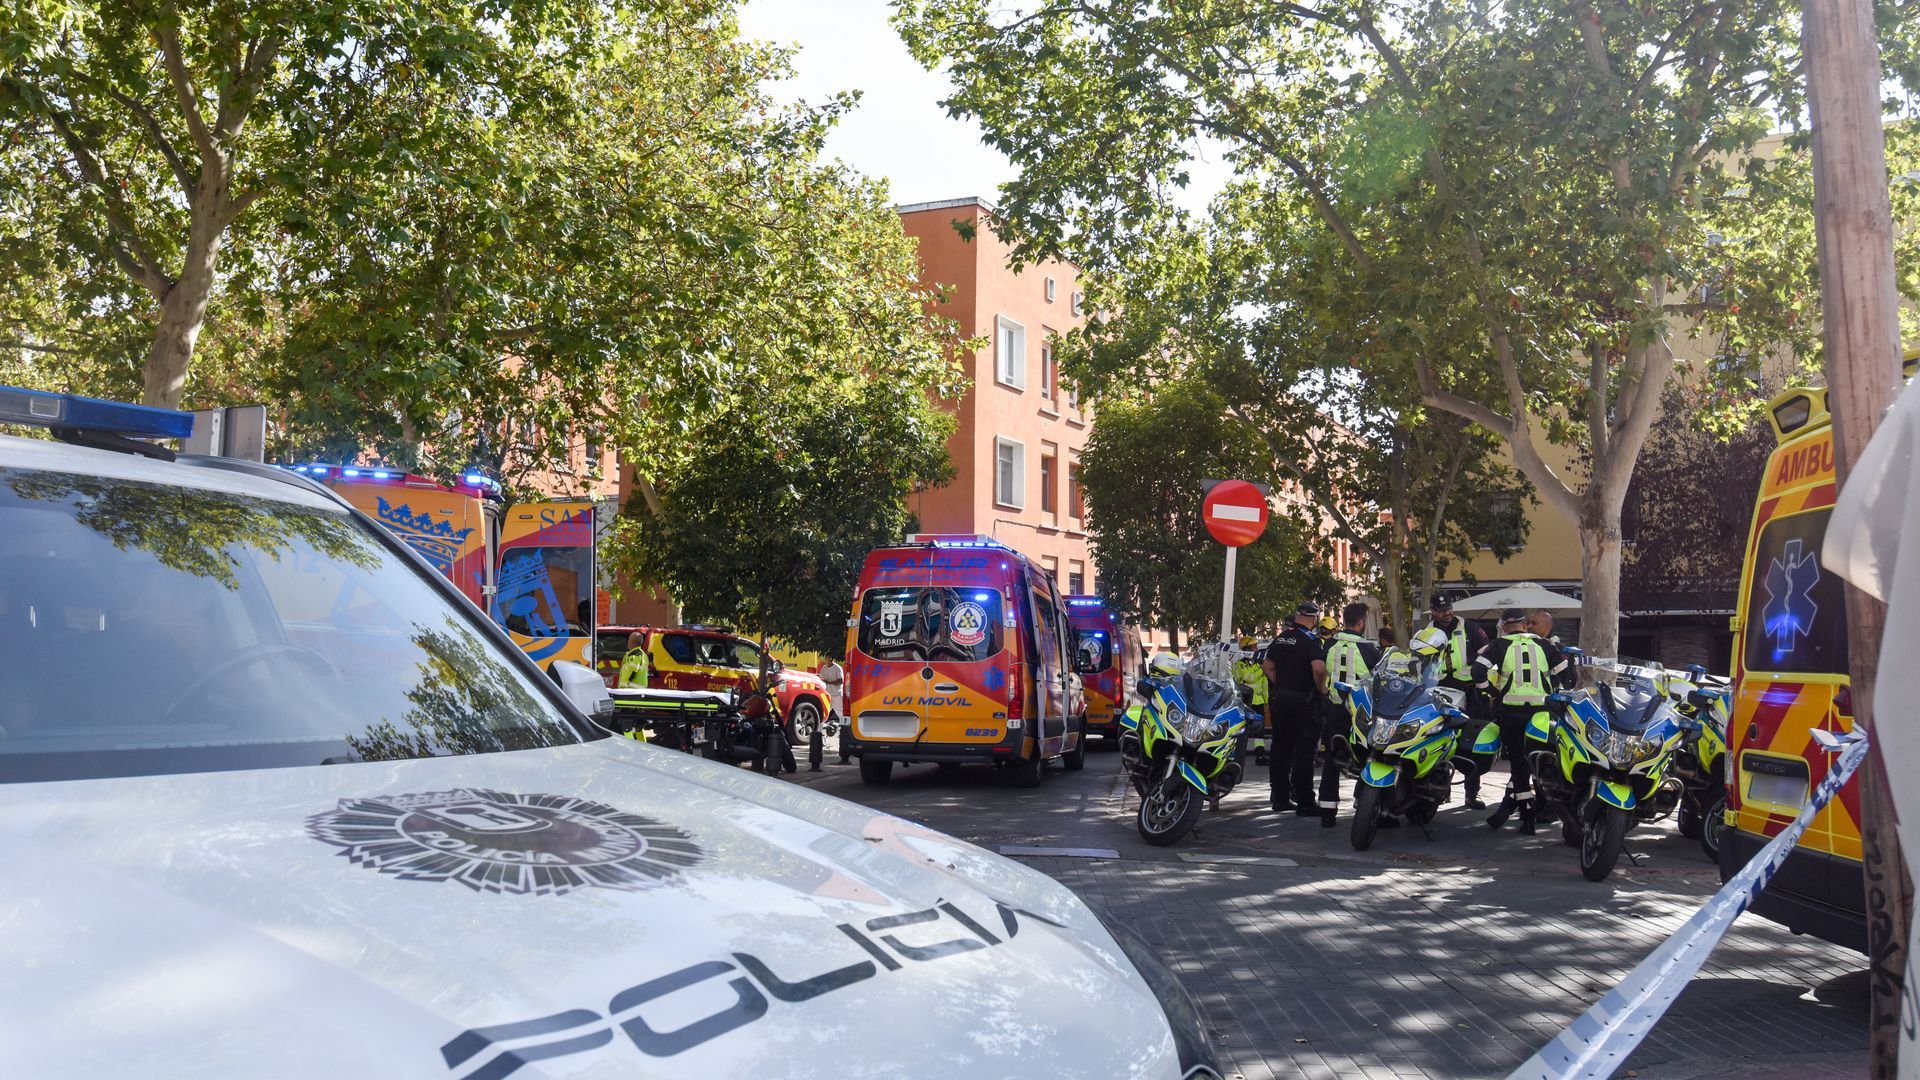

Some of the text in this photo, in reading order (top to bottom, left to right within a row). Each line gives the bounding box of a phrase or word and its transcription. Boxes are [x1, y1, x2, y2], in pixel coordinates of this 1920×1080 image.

[878, 557, 989, 573] SAMUR
[874, 638, 905, 646] MADRID
[667, 678, 678, 689] 112
[882, 695, 913, 705] UVI
